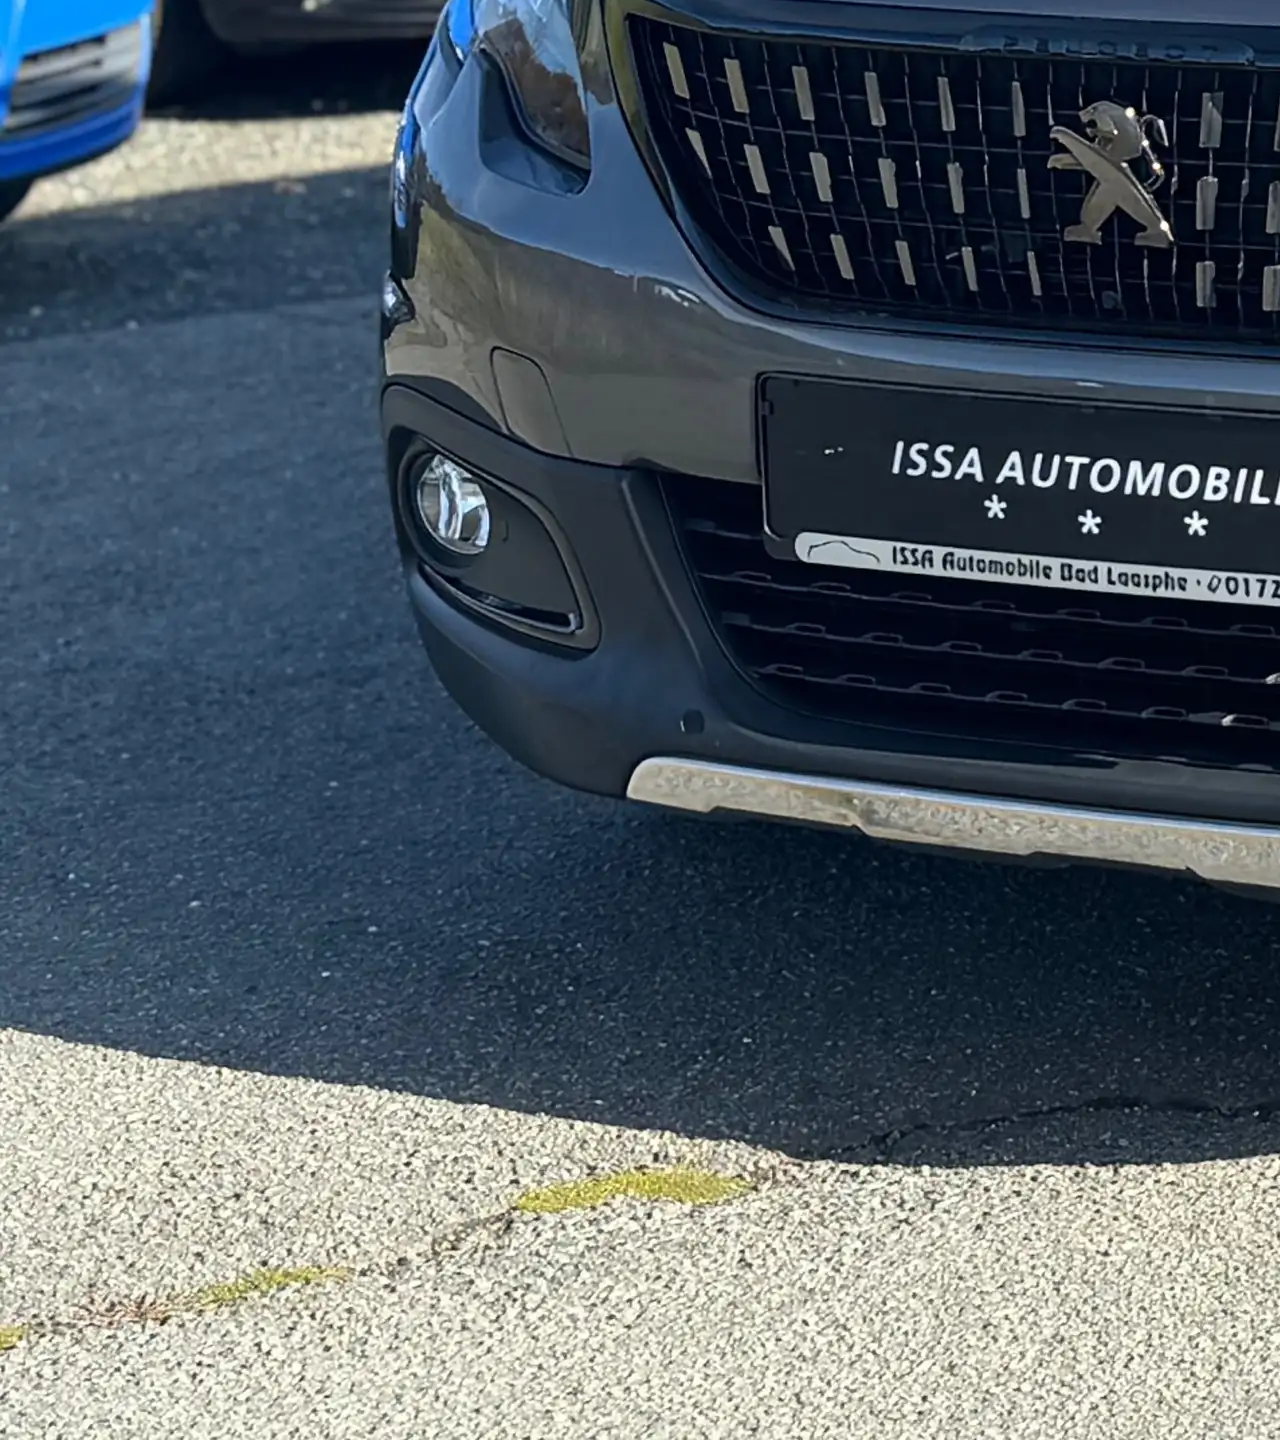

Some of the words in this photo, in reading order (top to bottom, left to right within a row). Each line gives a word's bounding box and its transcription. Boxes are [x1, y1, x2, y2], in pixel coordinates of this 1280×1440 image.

[891, 440, 985, 483] ISSA
[891, 544, 935, 570] ISSA
[940, 549, 1053, 581] Automobile
[1059, 561, 1100, 586] Bad
